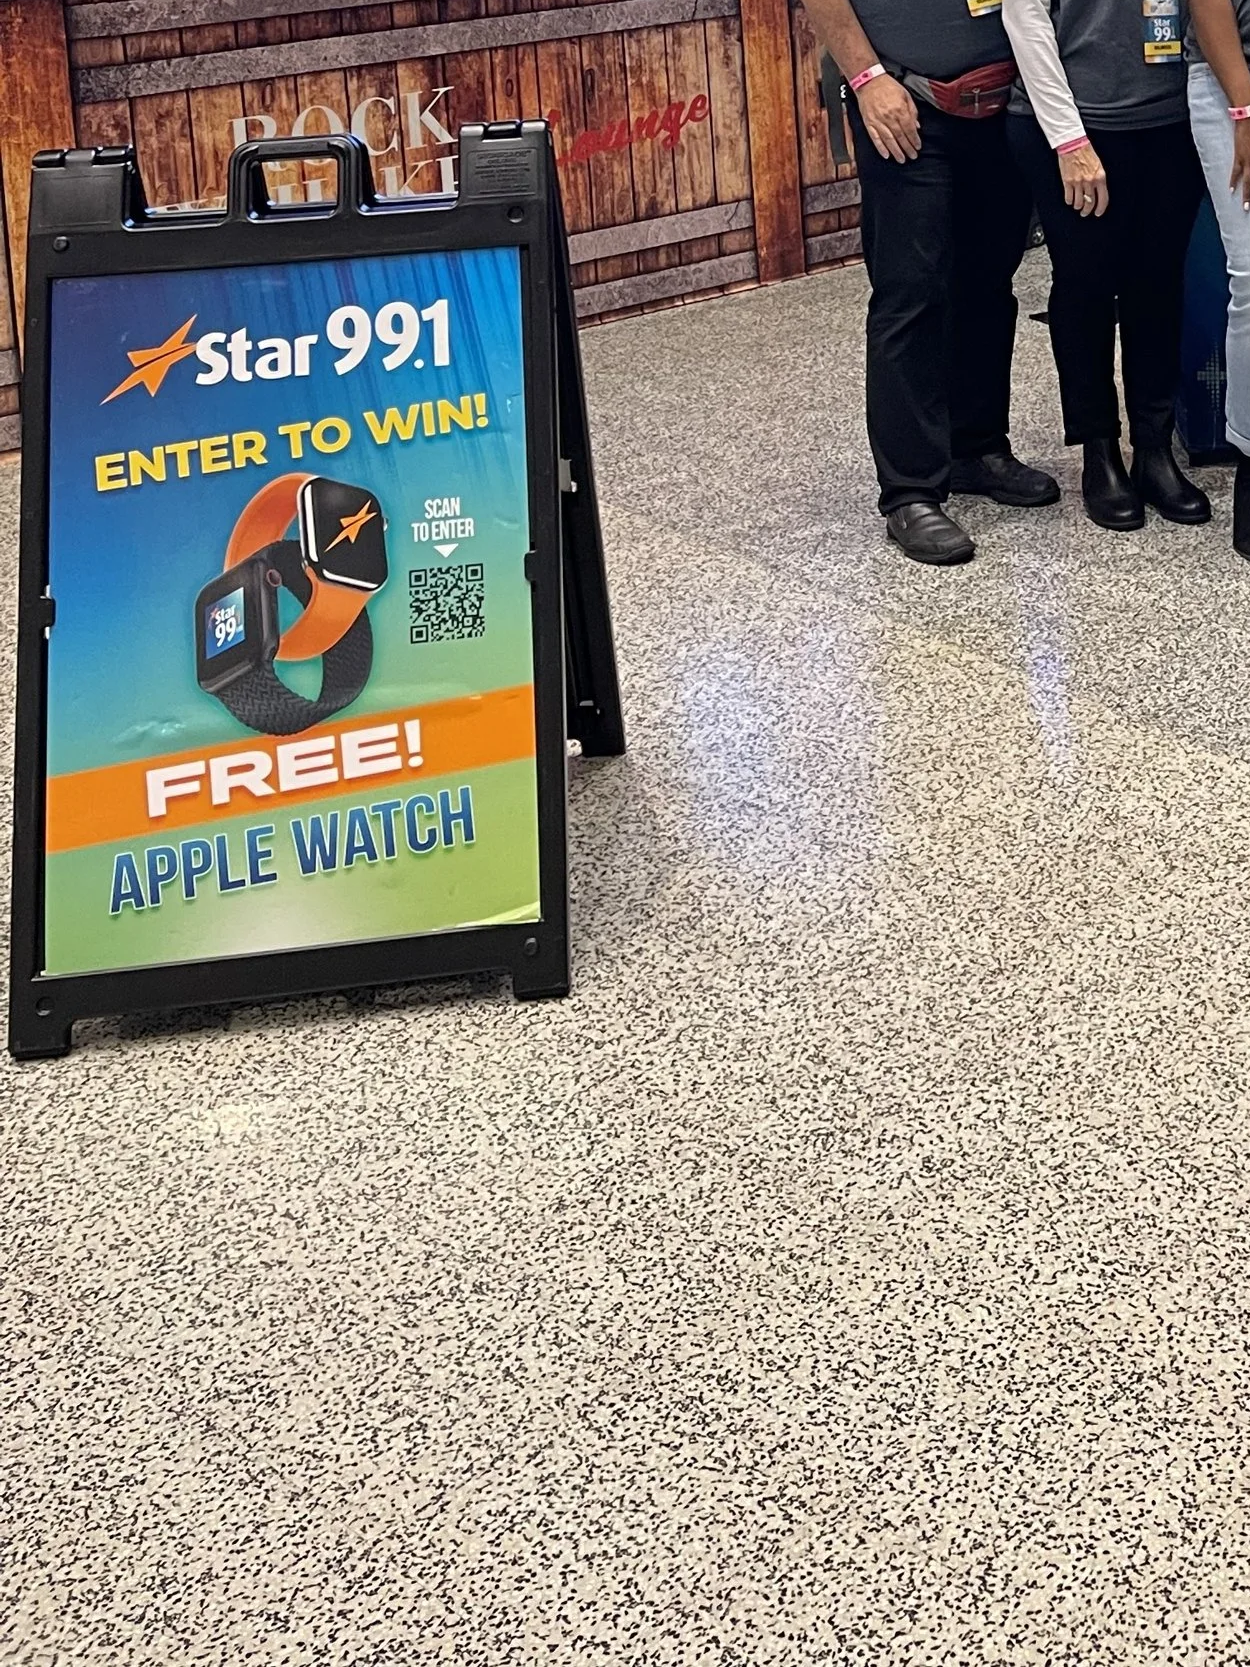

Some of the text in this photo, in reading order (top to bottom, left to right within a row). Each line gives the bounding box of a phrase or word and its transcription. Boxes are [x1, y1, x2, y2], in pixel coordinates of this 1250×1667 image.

[195, 299, 450, 385] Star 99.1
[94, 392, 489, 492] ENTER TO WIN!
[411, 518, 475, 543] TO ENTER
[424, 497, 460, 520] SCAN
[214, 605, 236, 625] Star
[145, 719, 424, 819] FREE!
[109, 785, 476, 915] APPLE WATCH
